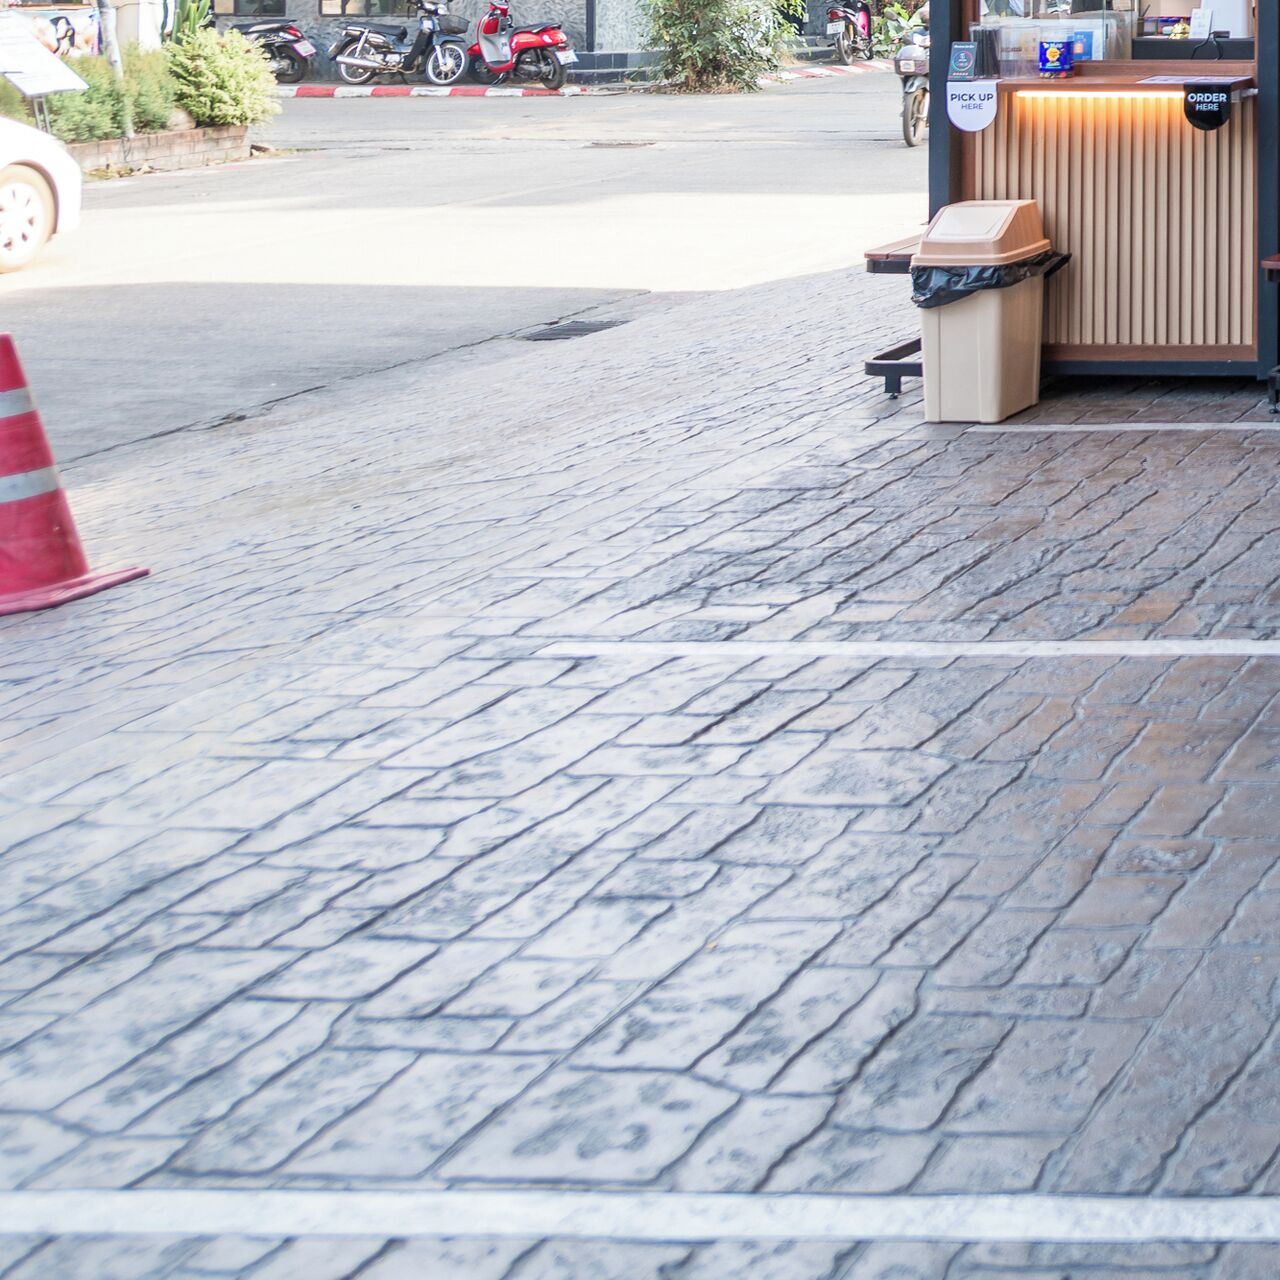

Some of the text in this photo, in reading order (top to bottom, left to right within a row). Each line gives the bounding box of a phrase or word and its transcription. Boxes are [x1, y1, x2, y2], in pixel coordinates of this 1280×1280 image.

[950, 93, 994, 102] PICK UP
[1187, 93, 1227, 103] ORDER
[1196, 103, 1219, 111] HERE
